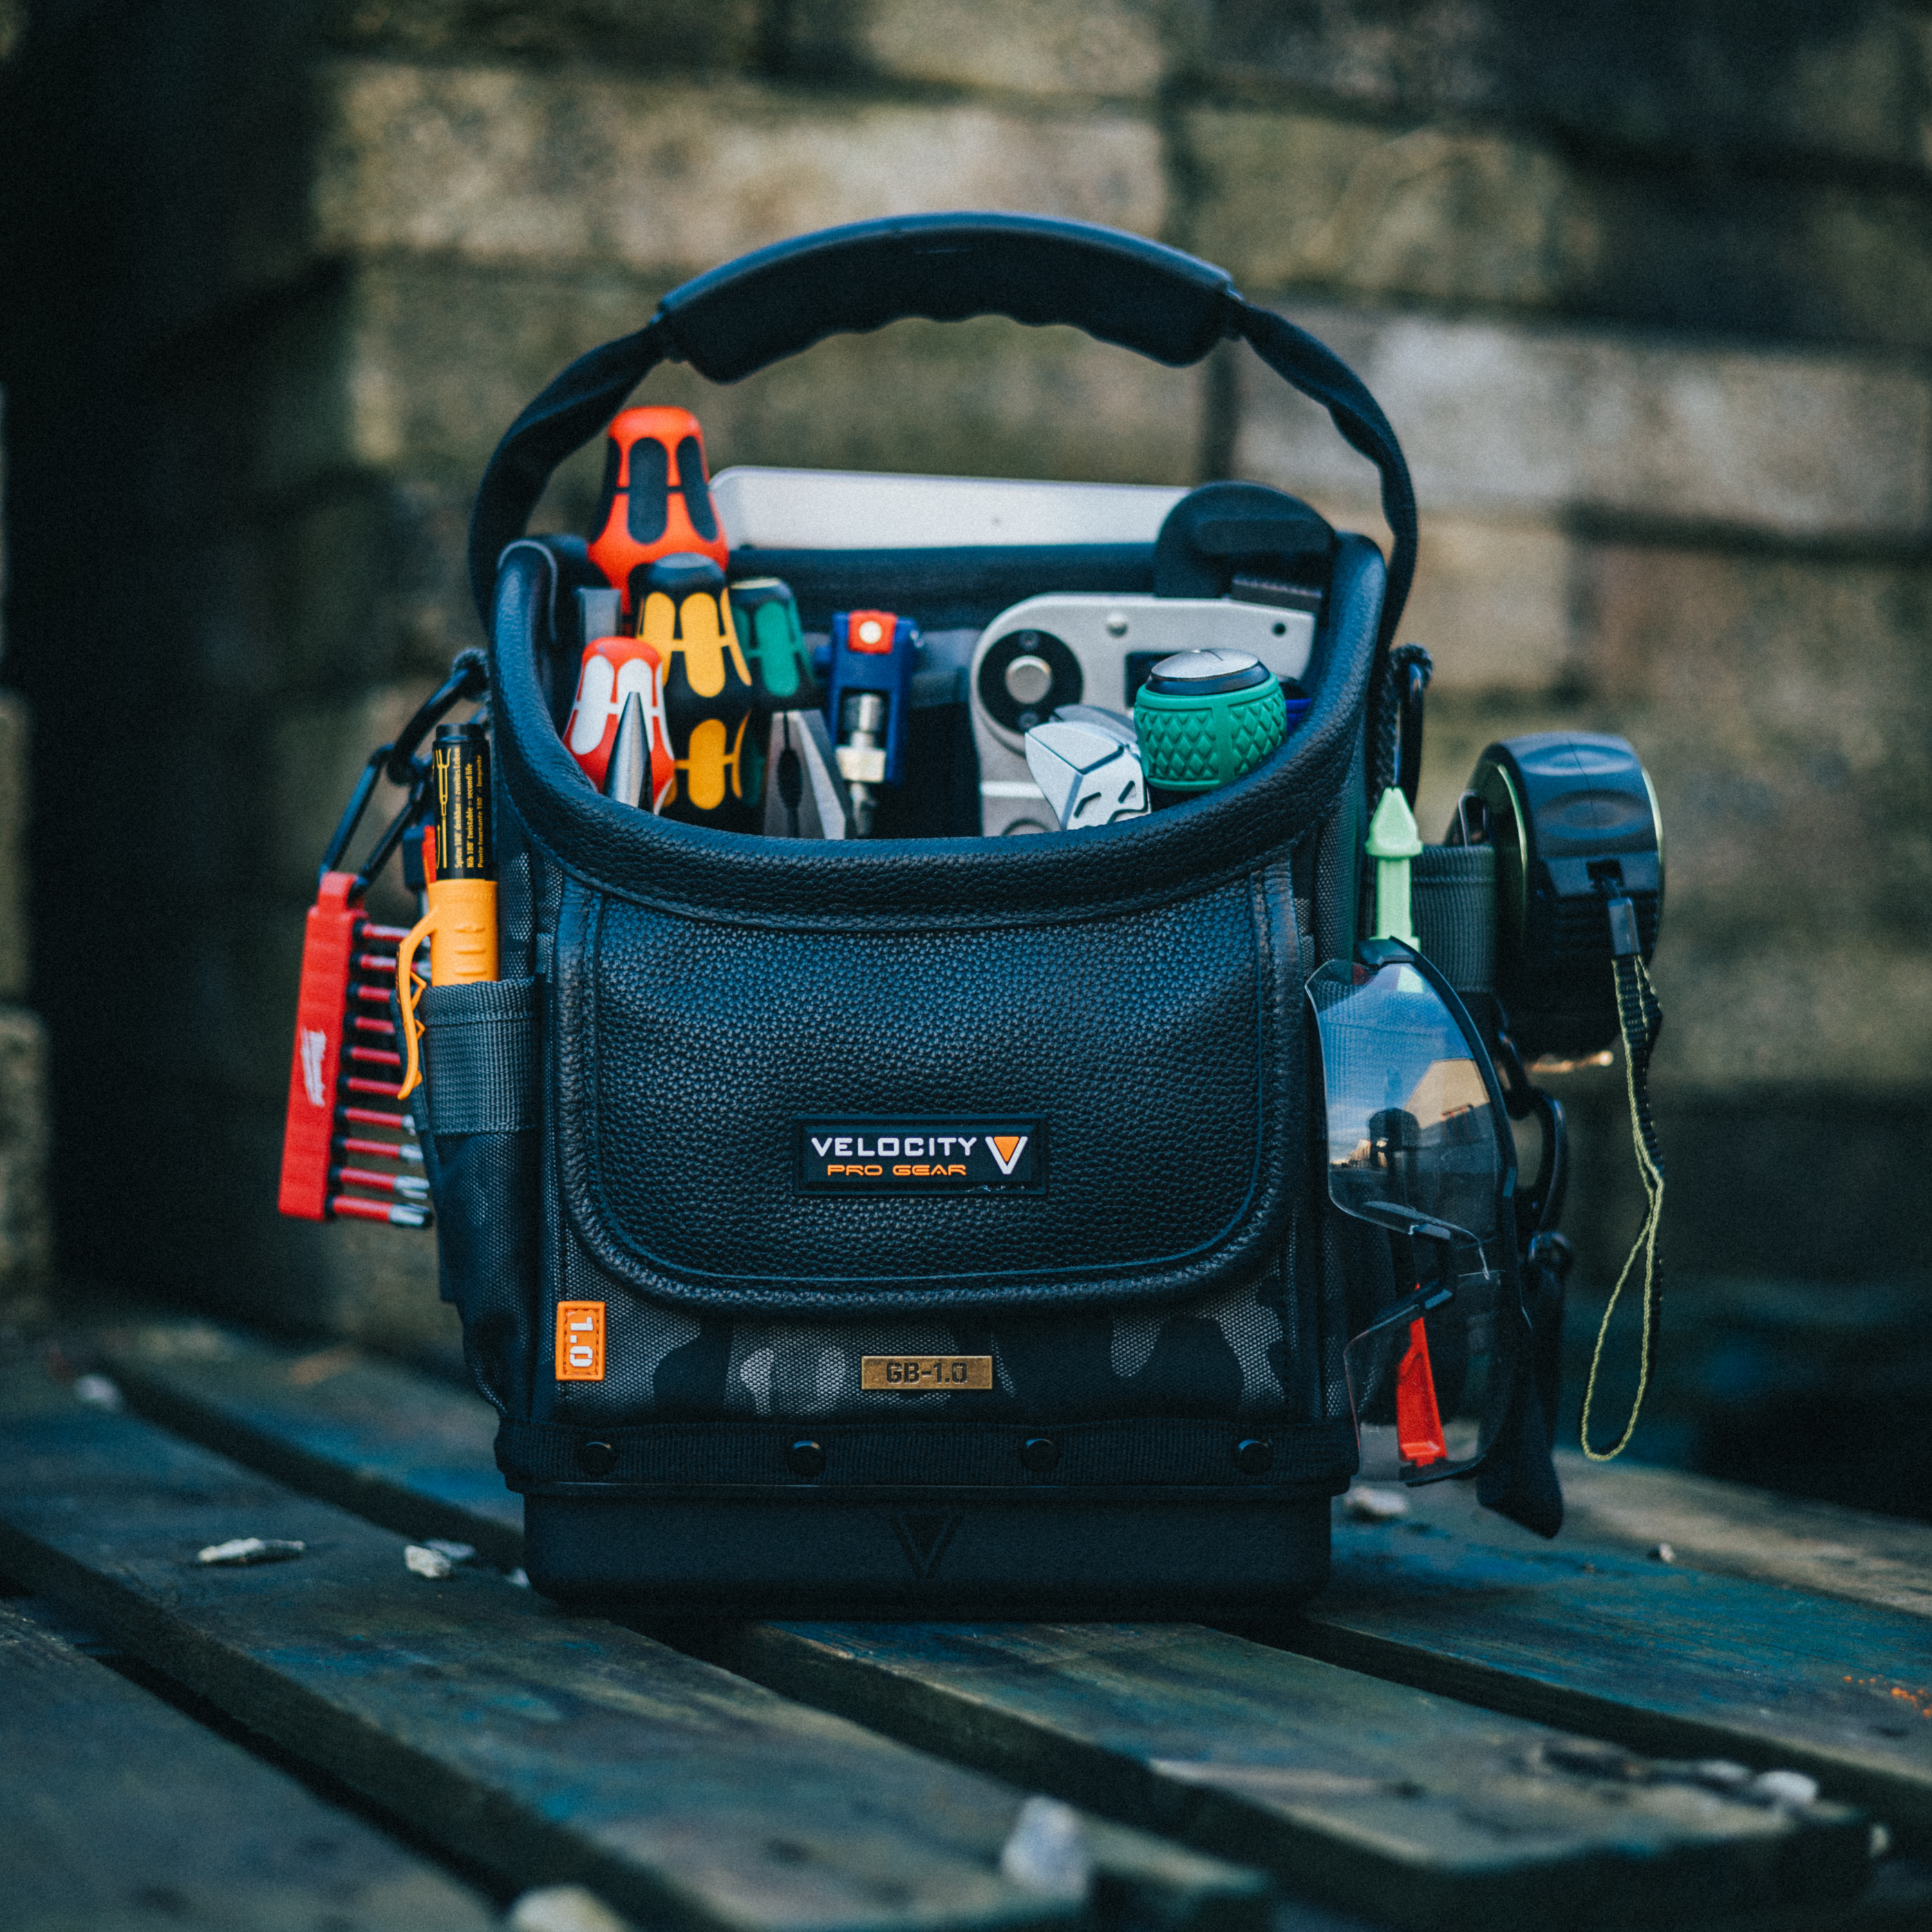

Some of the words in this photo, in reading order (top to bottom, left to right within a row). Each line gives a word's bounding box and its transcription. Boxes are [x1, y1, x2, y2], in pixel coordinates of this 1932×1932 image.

[453, 748, 461, 769] Leben
[453, 769, 461, 795] zweites
[454, 847, 464, 868] Spitze
[811, 1137, 977, 1156] VELOCITY
[827, 1165, 883, 1176] PRO
[892, 1165, 966, 1176] GEAR
[570, 1316, 594, 1367] 1.0
[886, 1362, 967, 1383] GB-1.0
